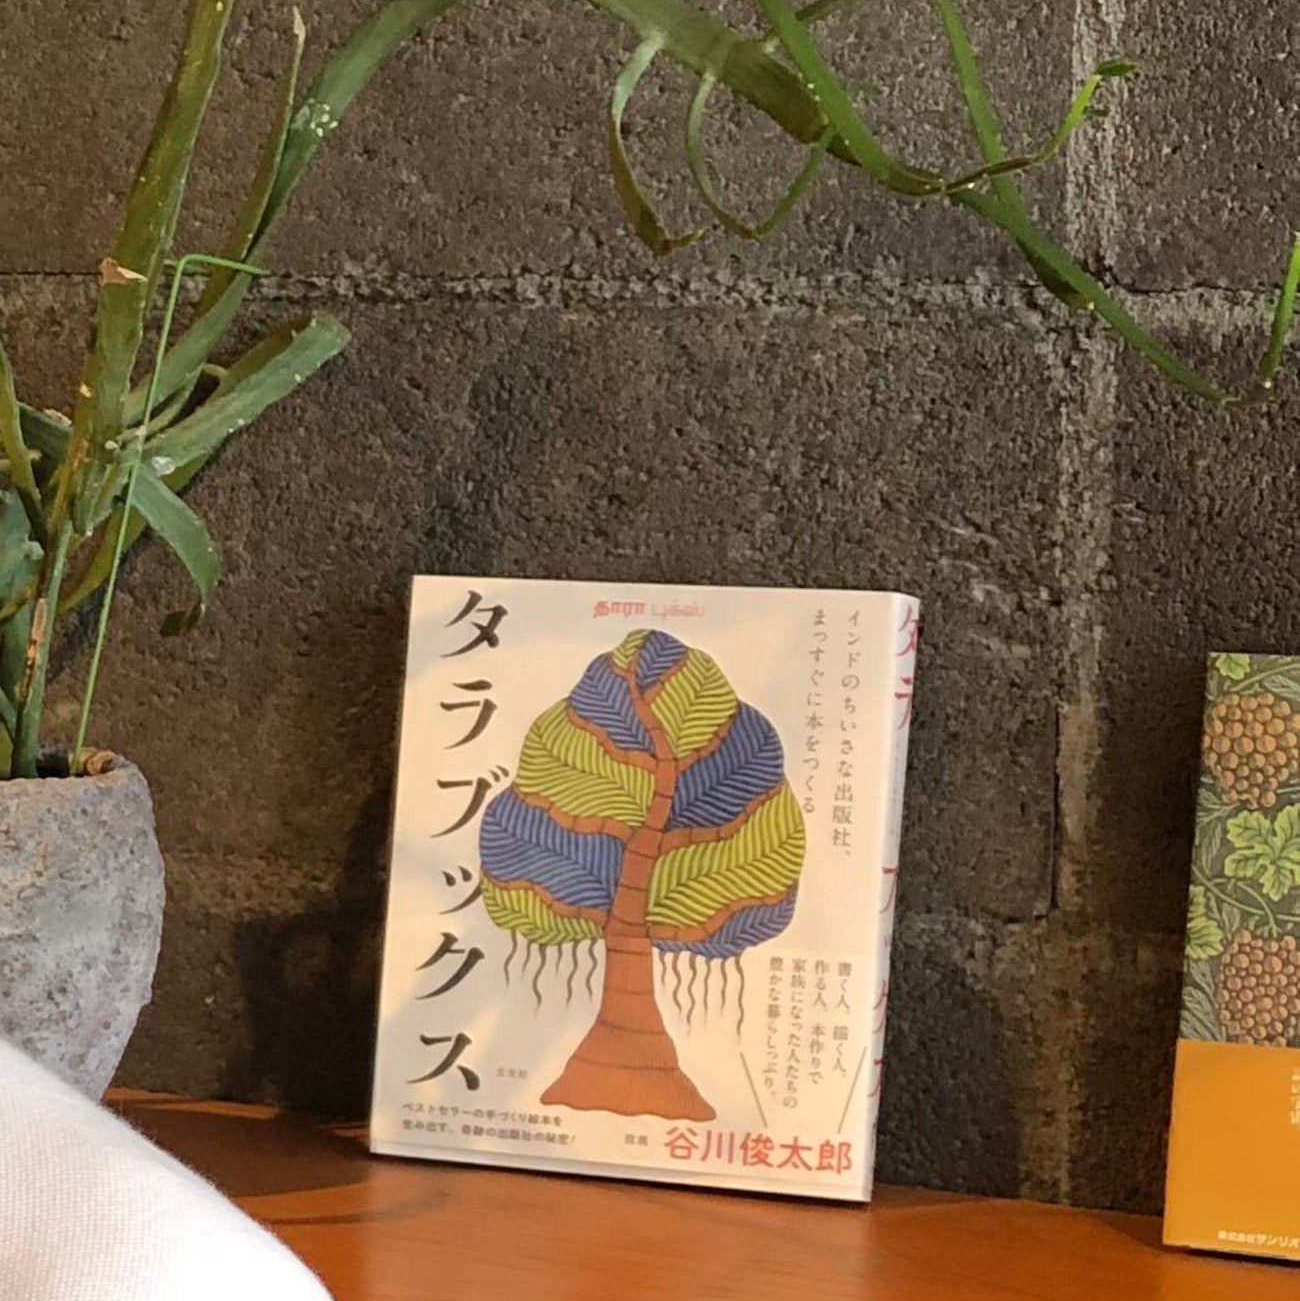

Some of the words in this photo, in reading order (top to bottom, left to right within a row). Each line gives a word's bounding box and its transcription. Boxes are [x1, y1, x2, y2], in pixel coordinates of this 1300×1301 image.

[801, 607, 828, 814] まっすぐに本をつくる
[406, 589, 509, 1093] タラブックス
[663, 1125, 854, 1175] 谷川俊太郎
